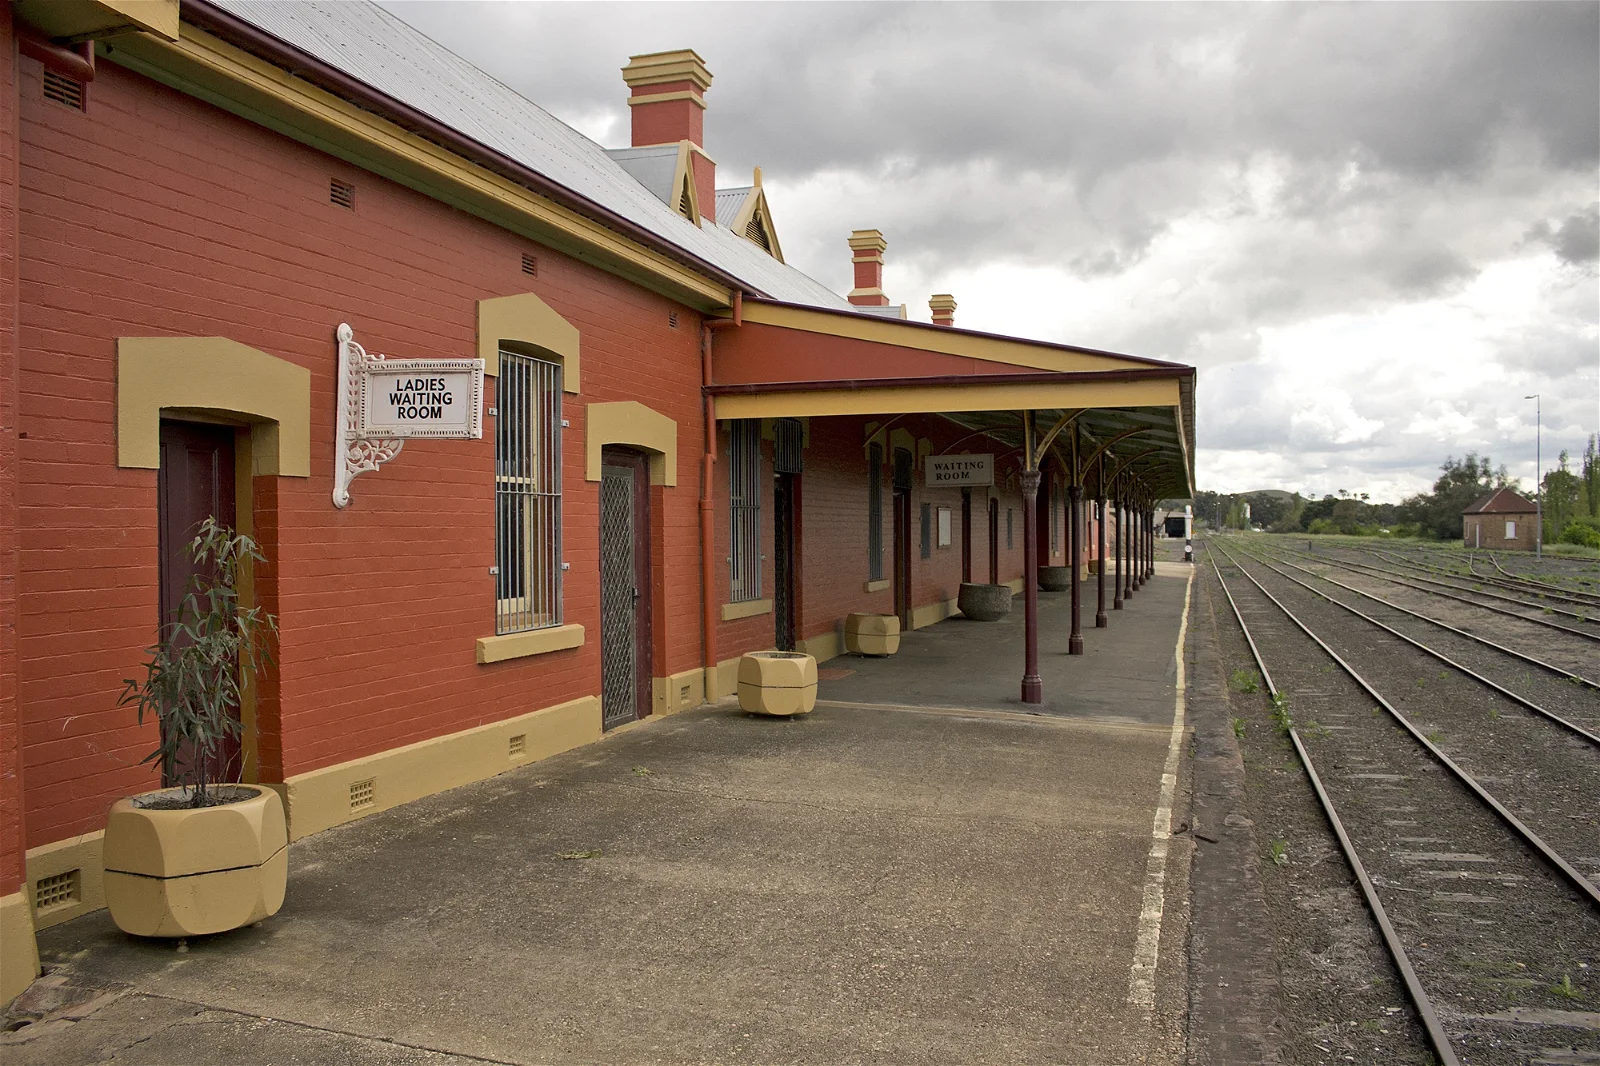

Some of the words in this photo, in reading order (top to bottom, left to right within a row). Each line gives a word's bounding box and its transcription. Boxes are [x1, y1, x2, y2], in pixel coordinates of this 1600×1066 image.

[396, 378, 445, 391] LADIES
[389, 392, 452, 405] WAITING
[397, 406, 442, 419] ROOM
[934, 461, 984, 470] WAITING
[936, 471, 970, 480] ROOM
